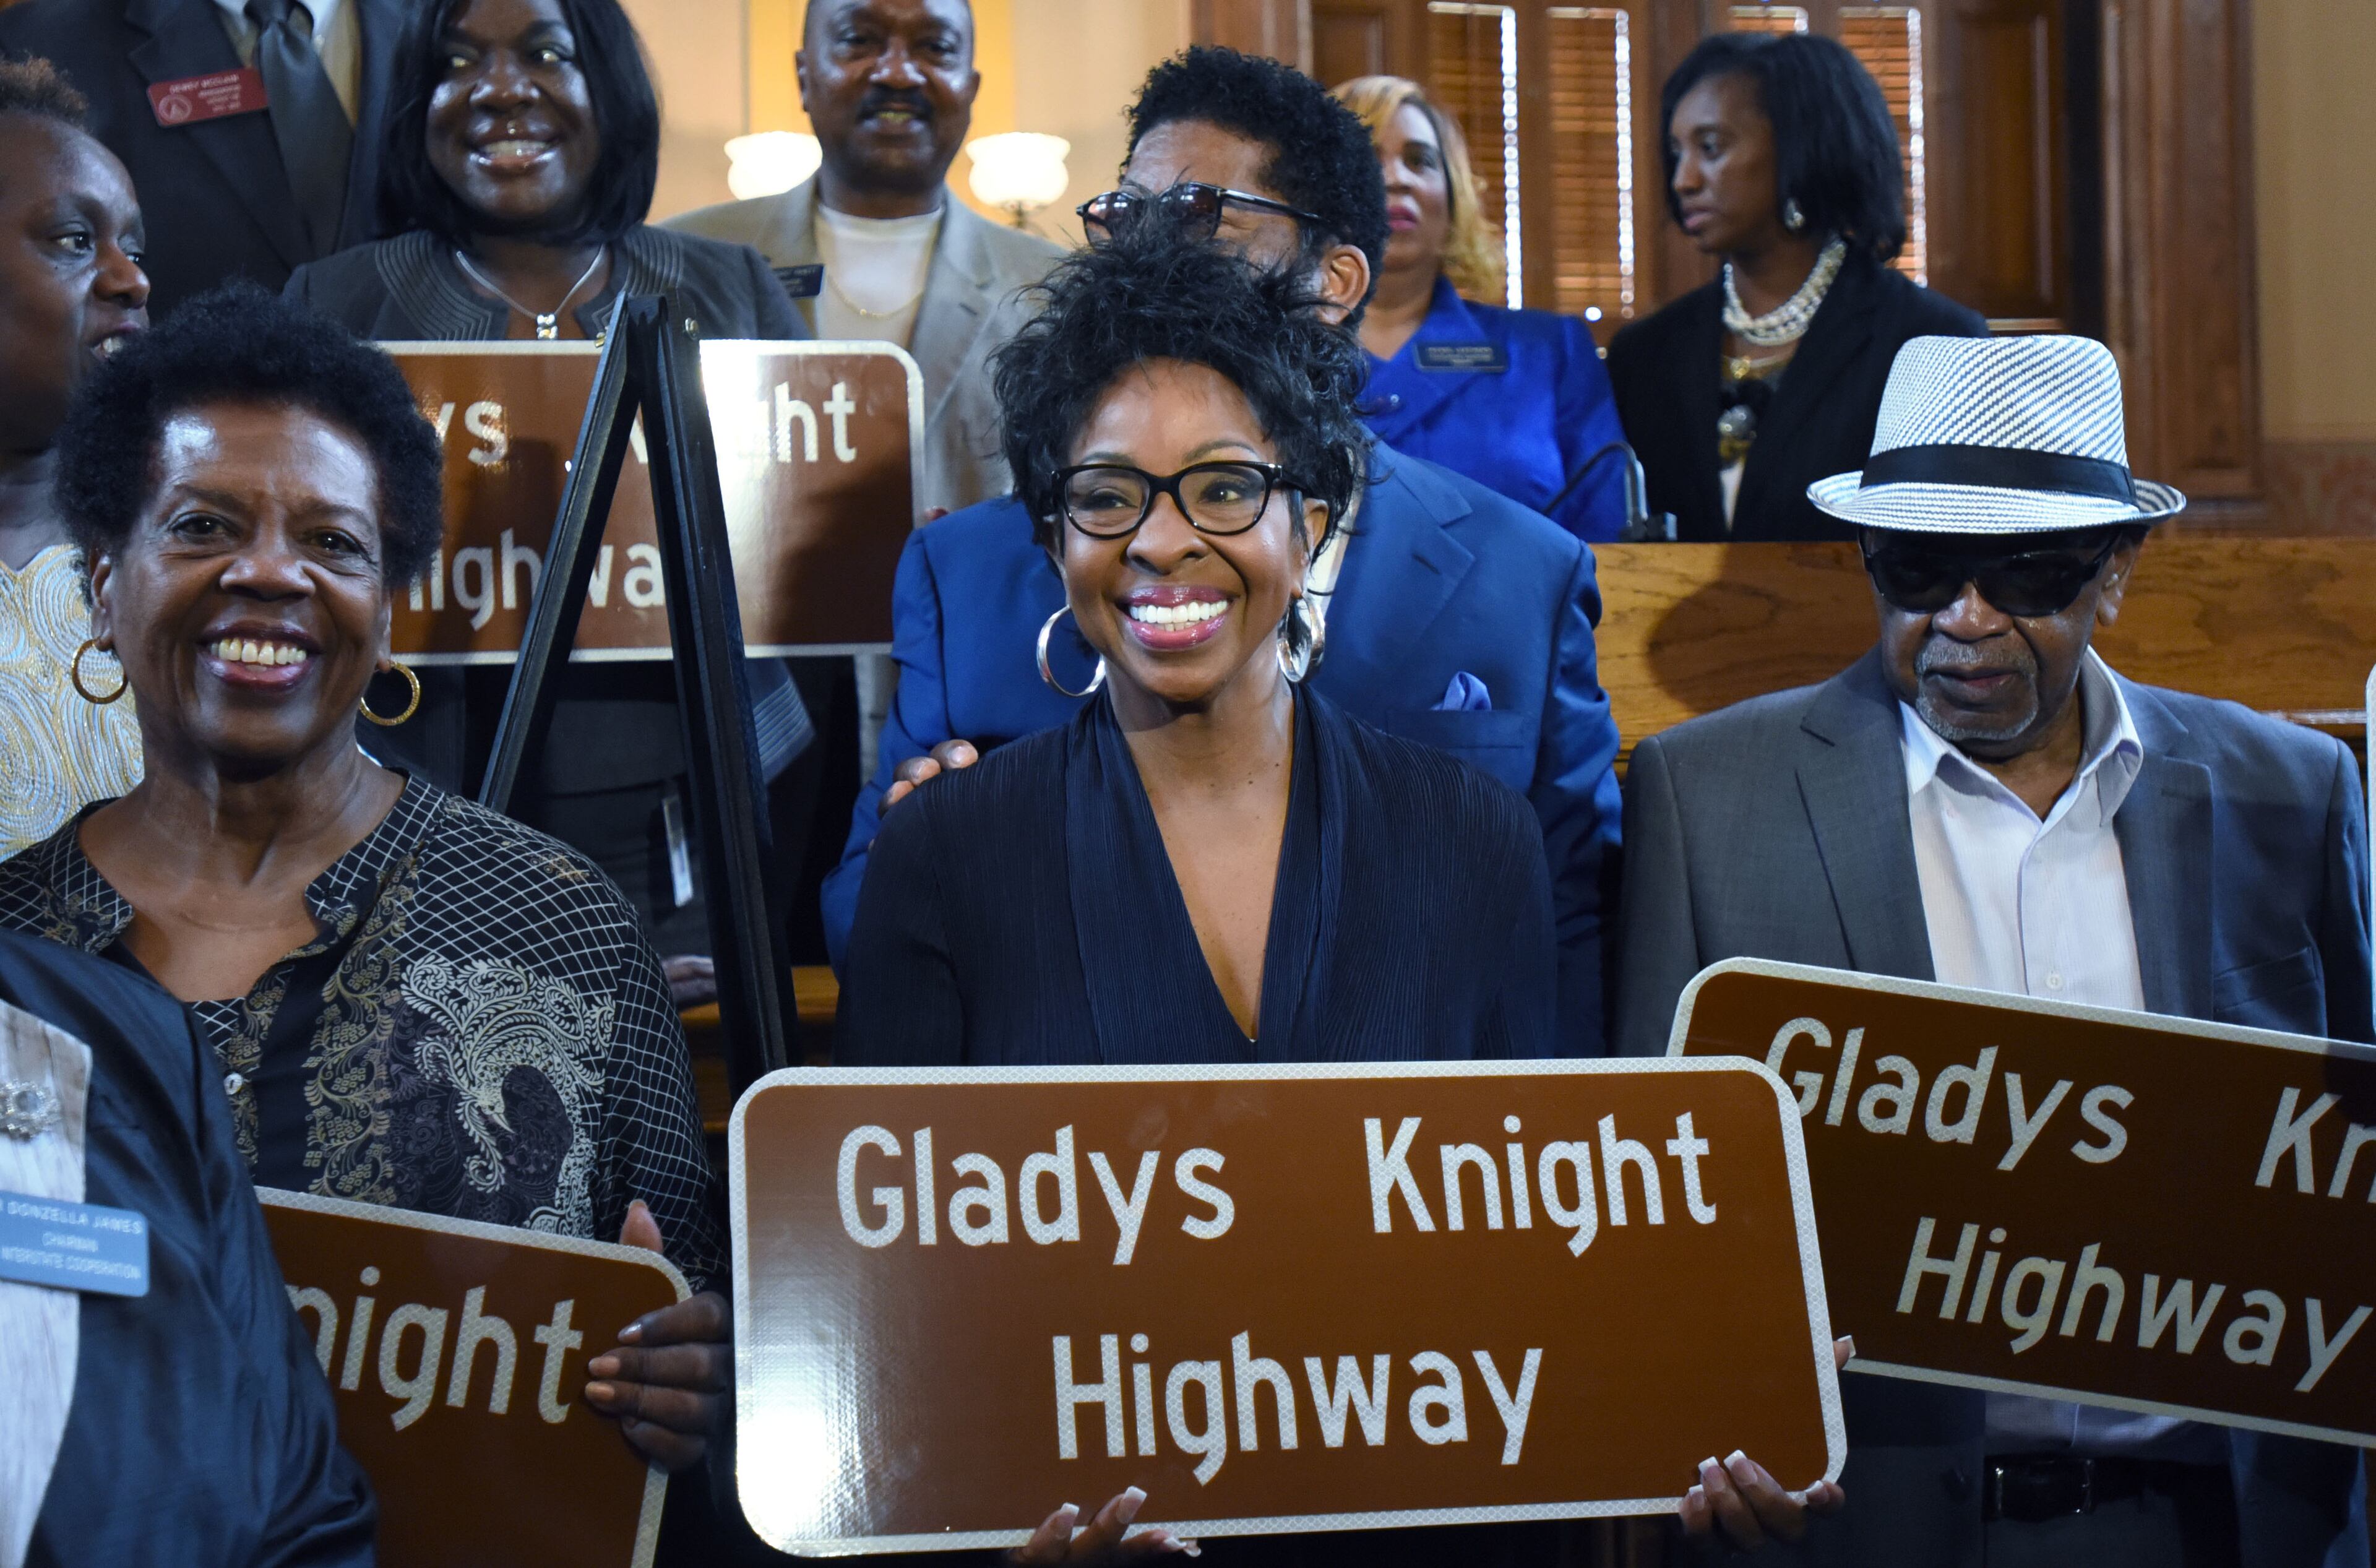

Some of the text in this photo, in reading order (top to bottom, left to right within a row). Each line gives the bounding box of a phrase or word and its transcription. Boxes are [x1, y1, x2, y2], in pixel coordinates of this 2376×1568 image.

[1765, 1016, 2135, 1171] Gladys
[92, 1216, 143, 1234] JAMES
[836, 1111, 1716, 1266] Gladys Knight
[285, 1265, 583, 1432] night
[1896, 1217, 2374, 1392] Highway
[1052, 1330, 1543, 1486] Highway
